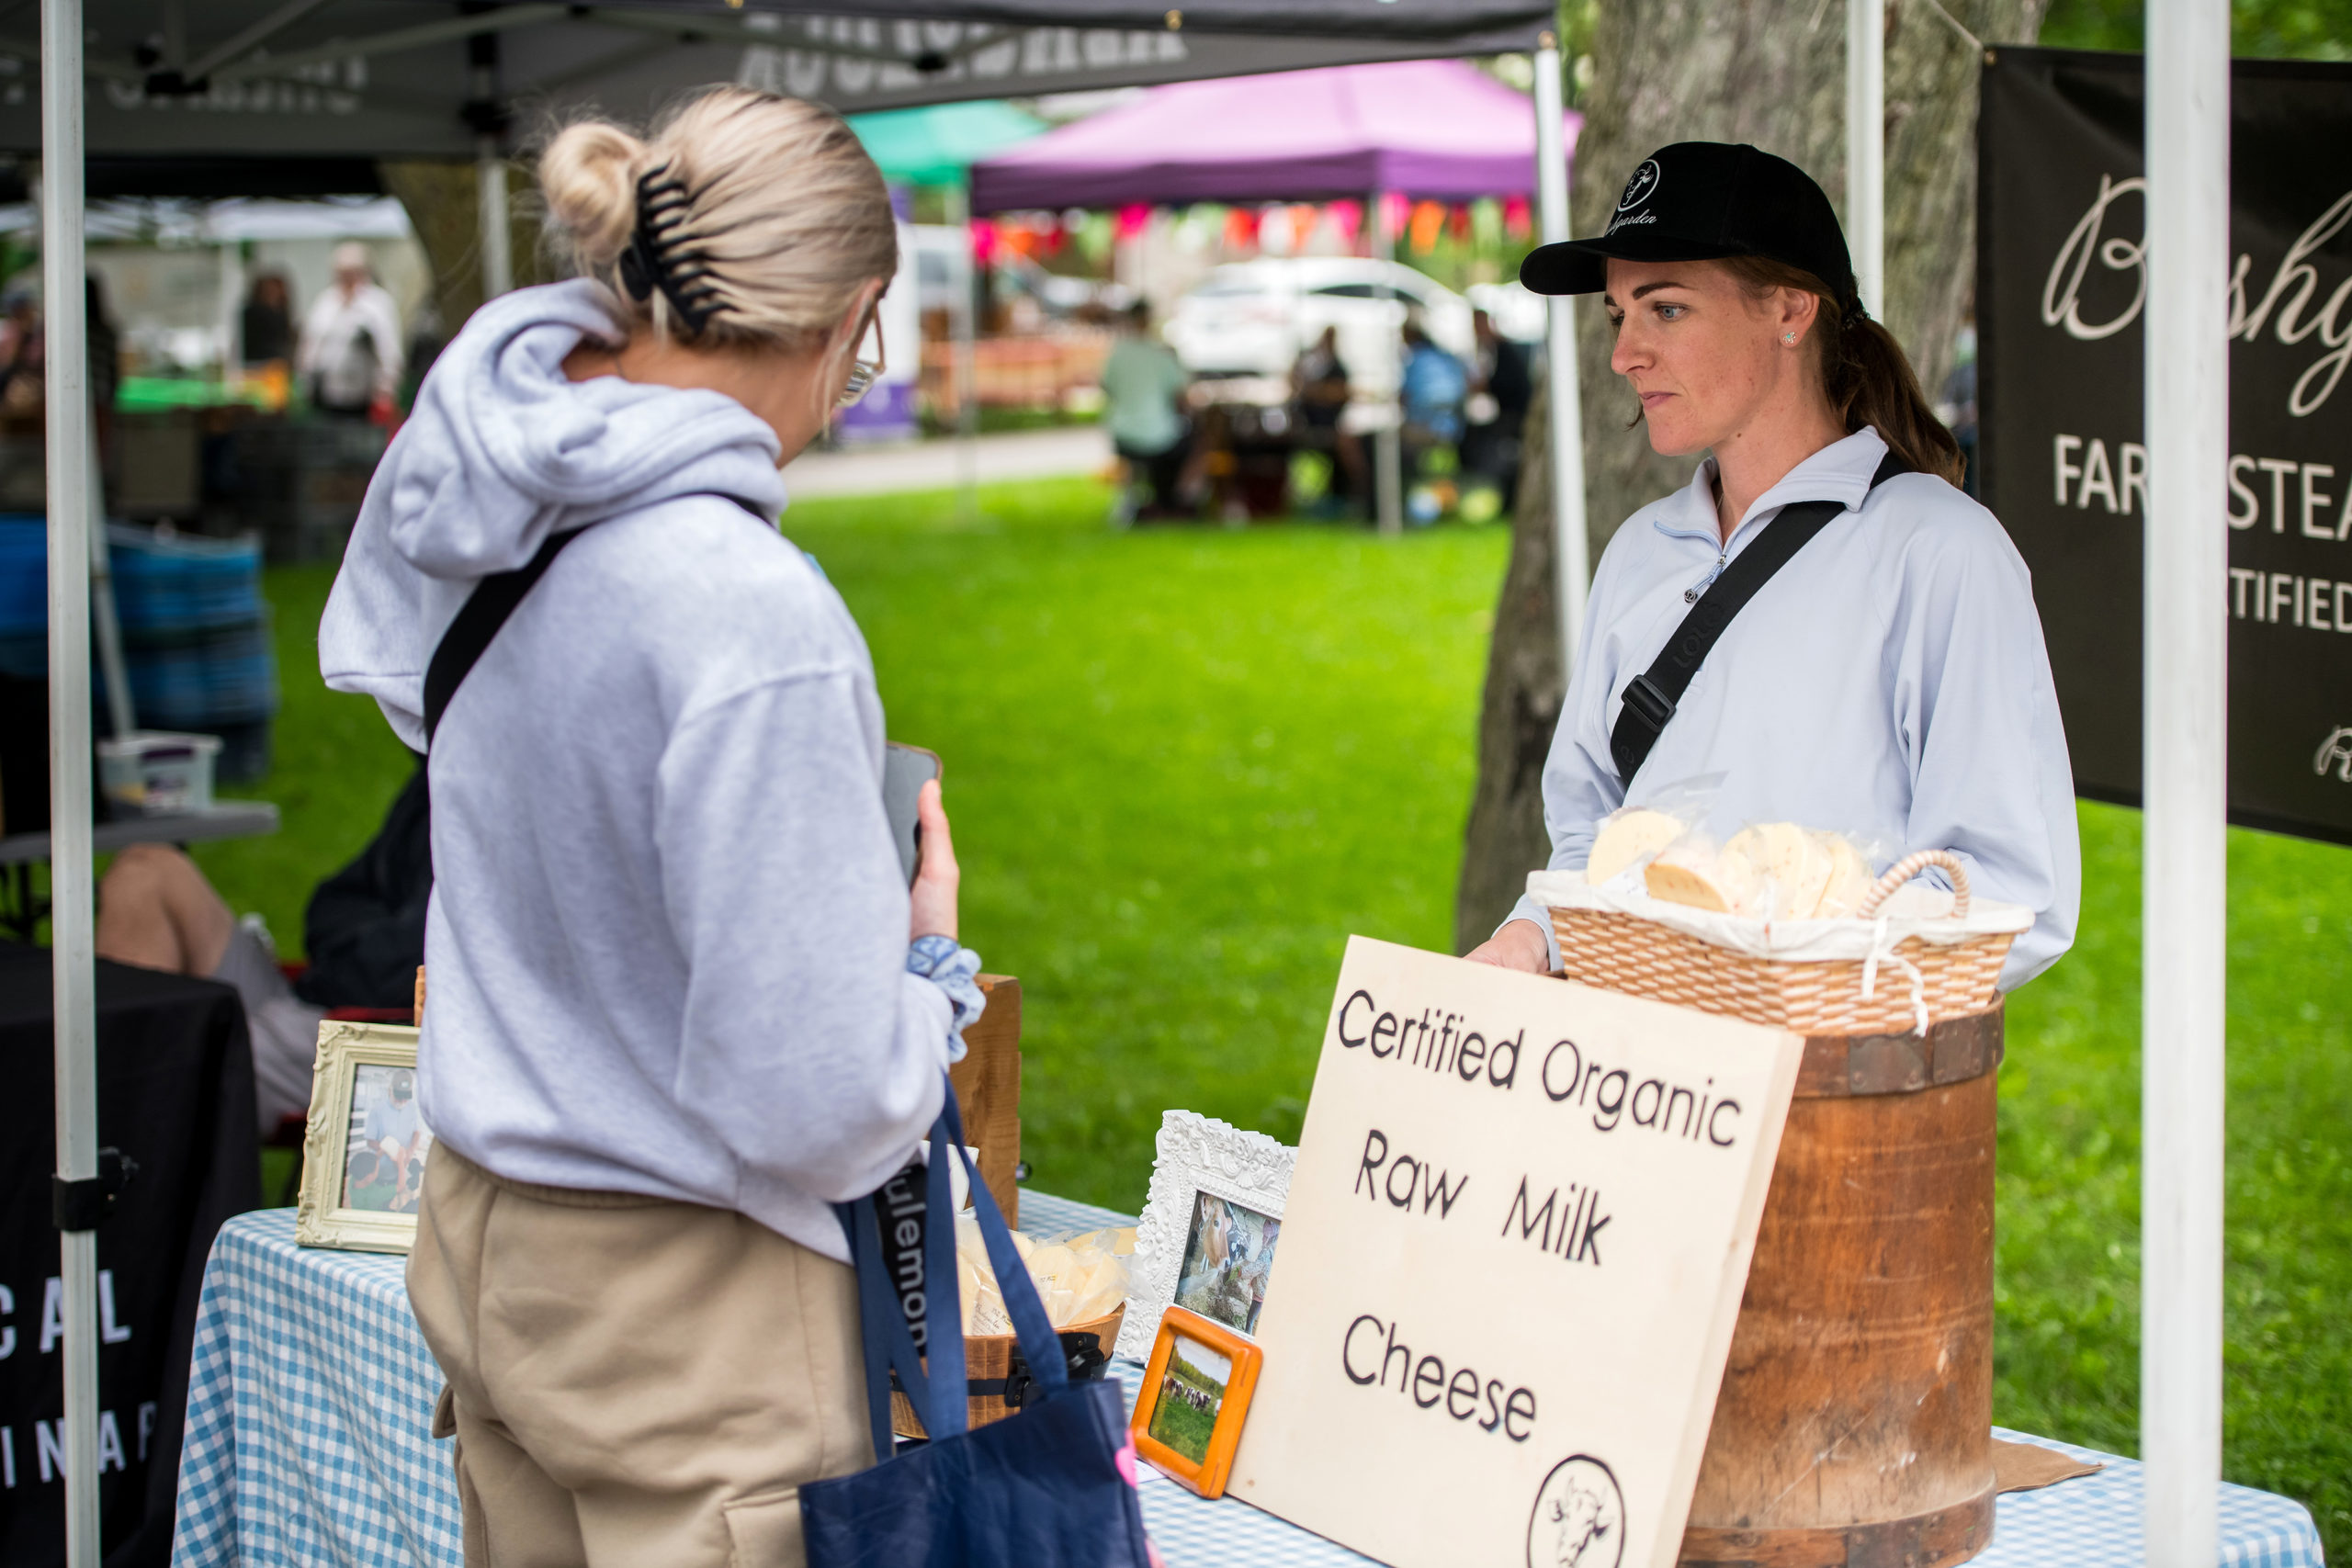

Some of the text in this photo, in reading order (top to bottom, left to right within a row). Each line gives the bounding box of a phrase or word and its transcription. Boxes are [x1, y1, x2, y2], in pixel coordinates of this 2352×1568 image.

[2227, 567, 2352, 634] TIFIED
[1338, 988, 1743, 1148] Certified Organic
[884, 1168, 928, 1348] ulemon
[1354, 1129, 1612, 1266] Raw Milk
[1342, 1314, 1536, 1443] Cheese
